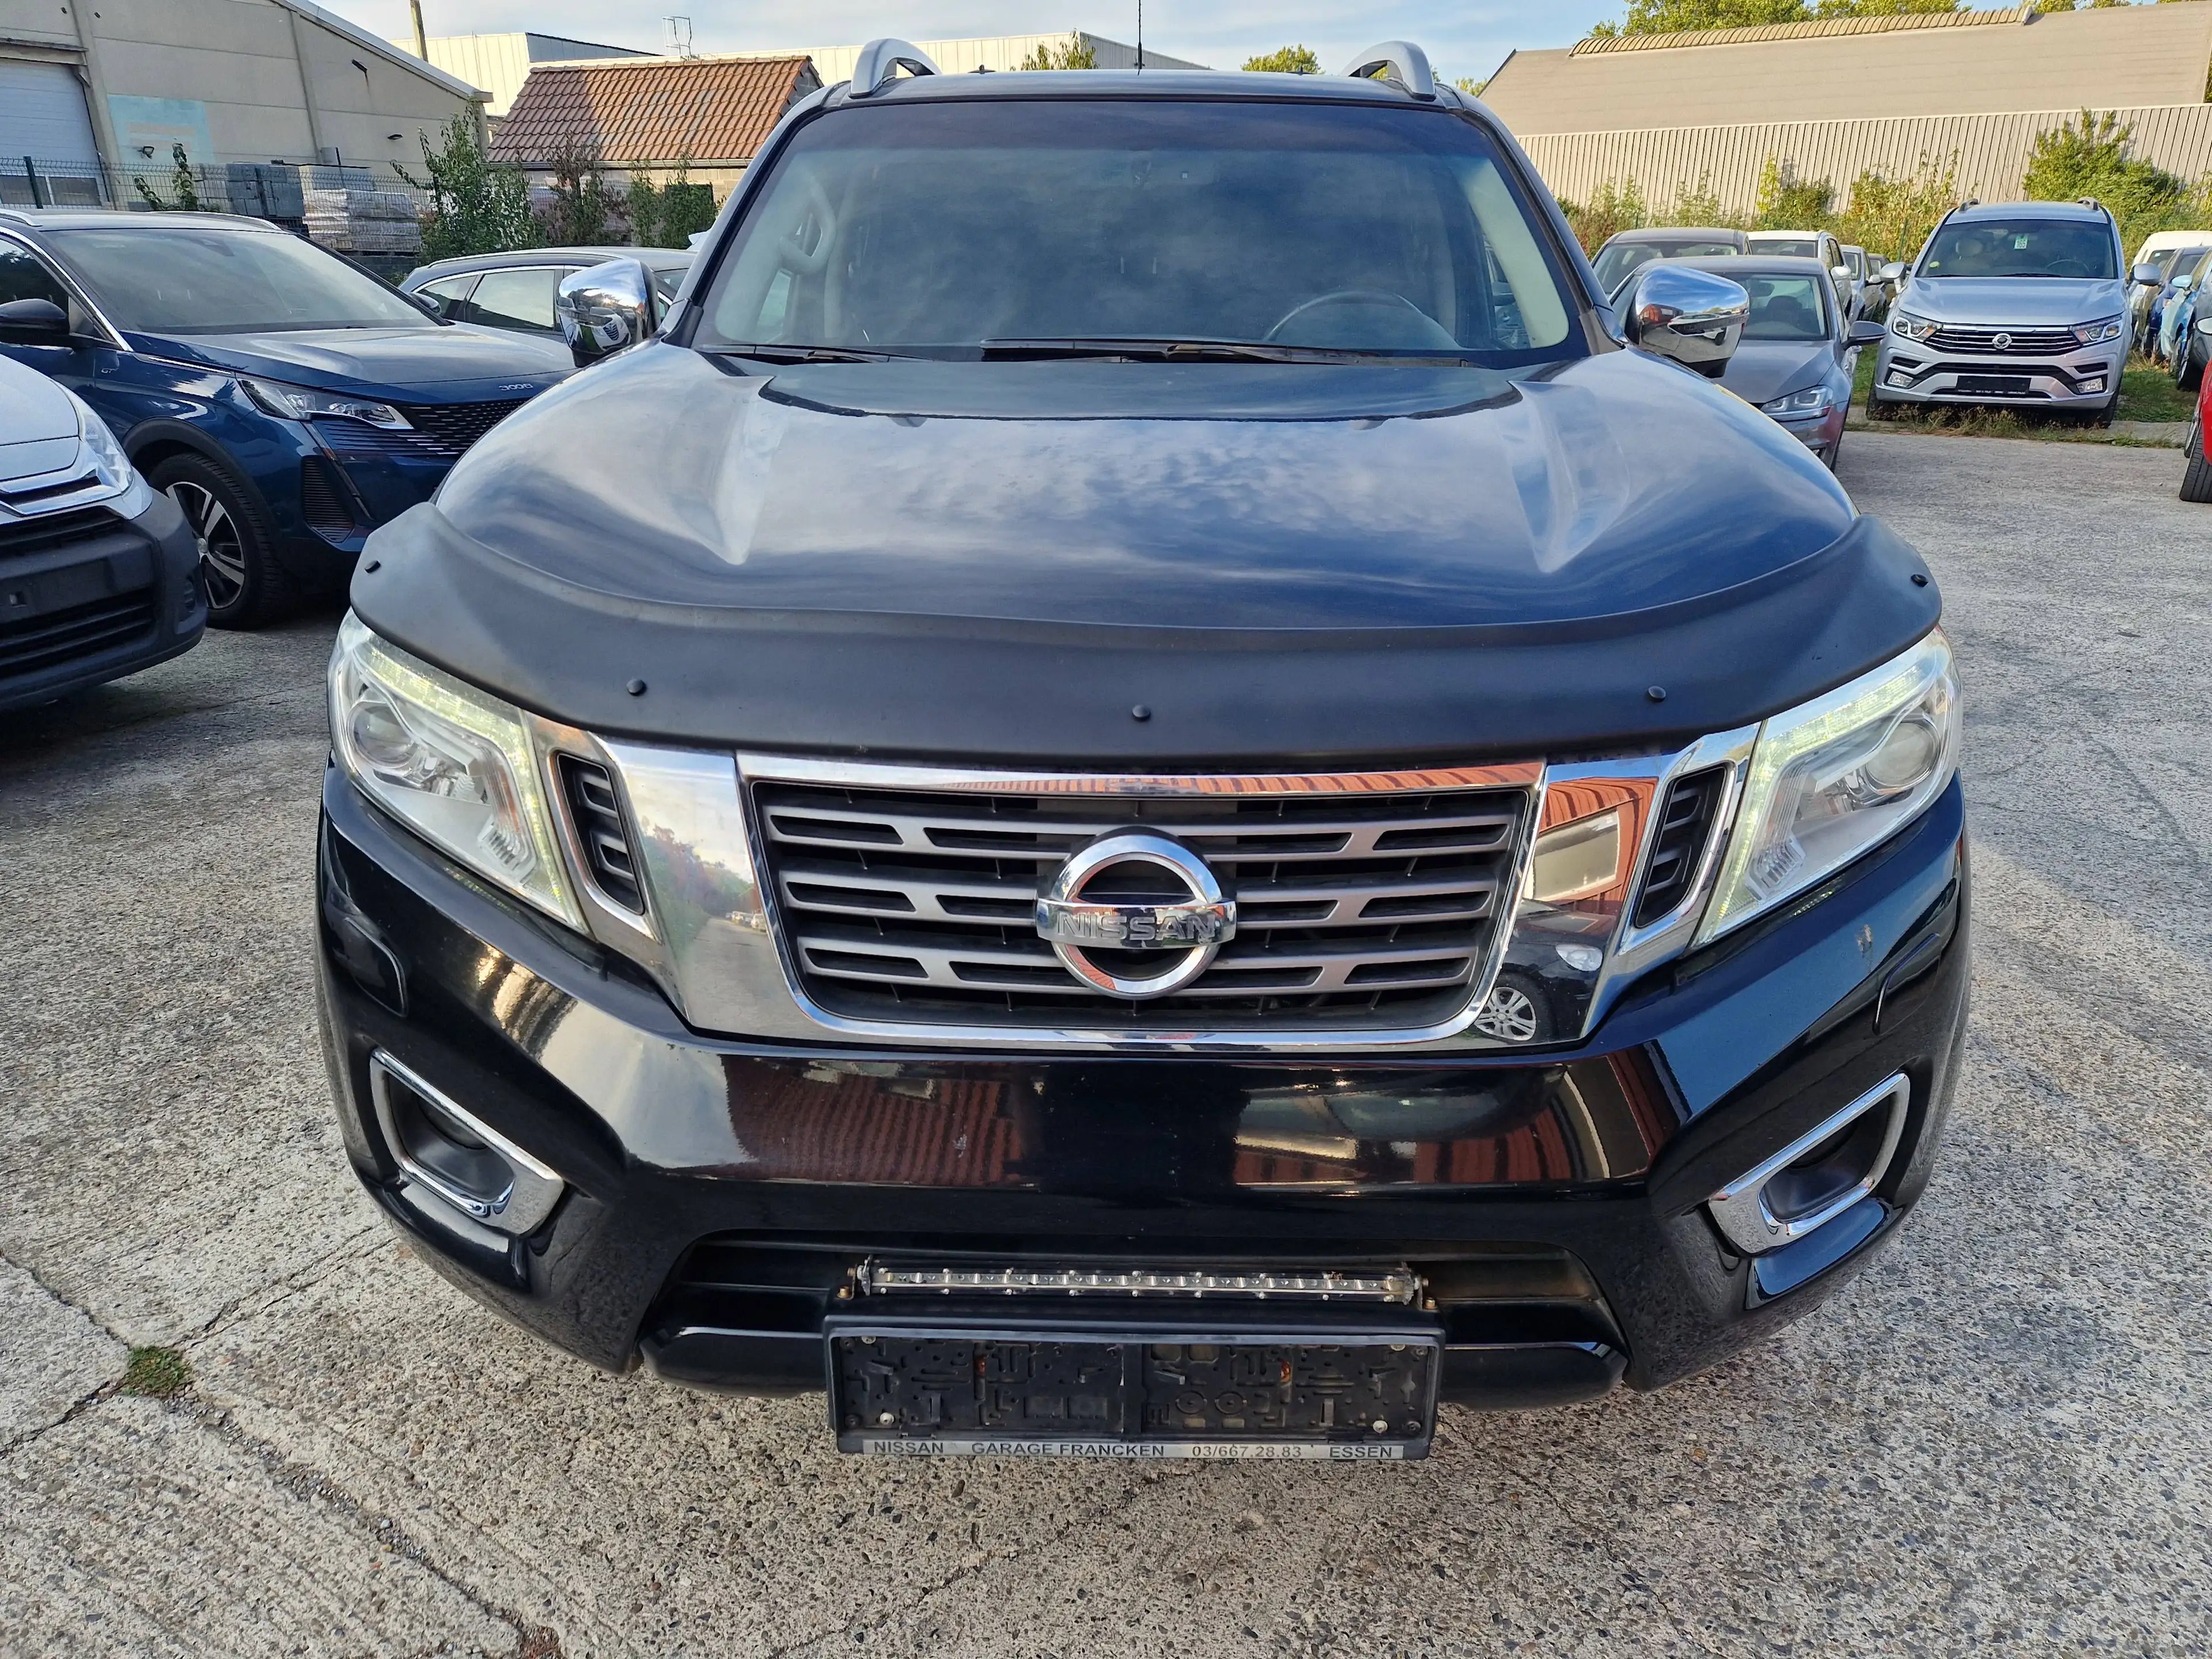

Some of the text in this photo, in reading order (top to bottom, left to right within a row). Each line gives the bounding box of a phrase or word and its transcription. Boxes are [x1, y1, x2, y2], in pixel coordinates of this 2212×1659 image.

[498, 383, 534, 391] 3008
[1056, 910, 1215, 941] NISSAN
[873, 1441, 1392, 1459] NISSAN GARAGE FRANCKEN 03/667.28.83 ESSEN
